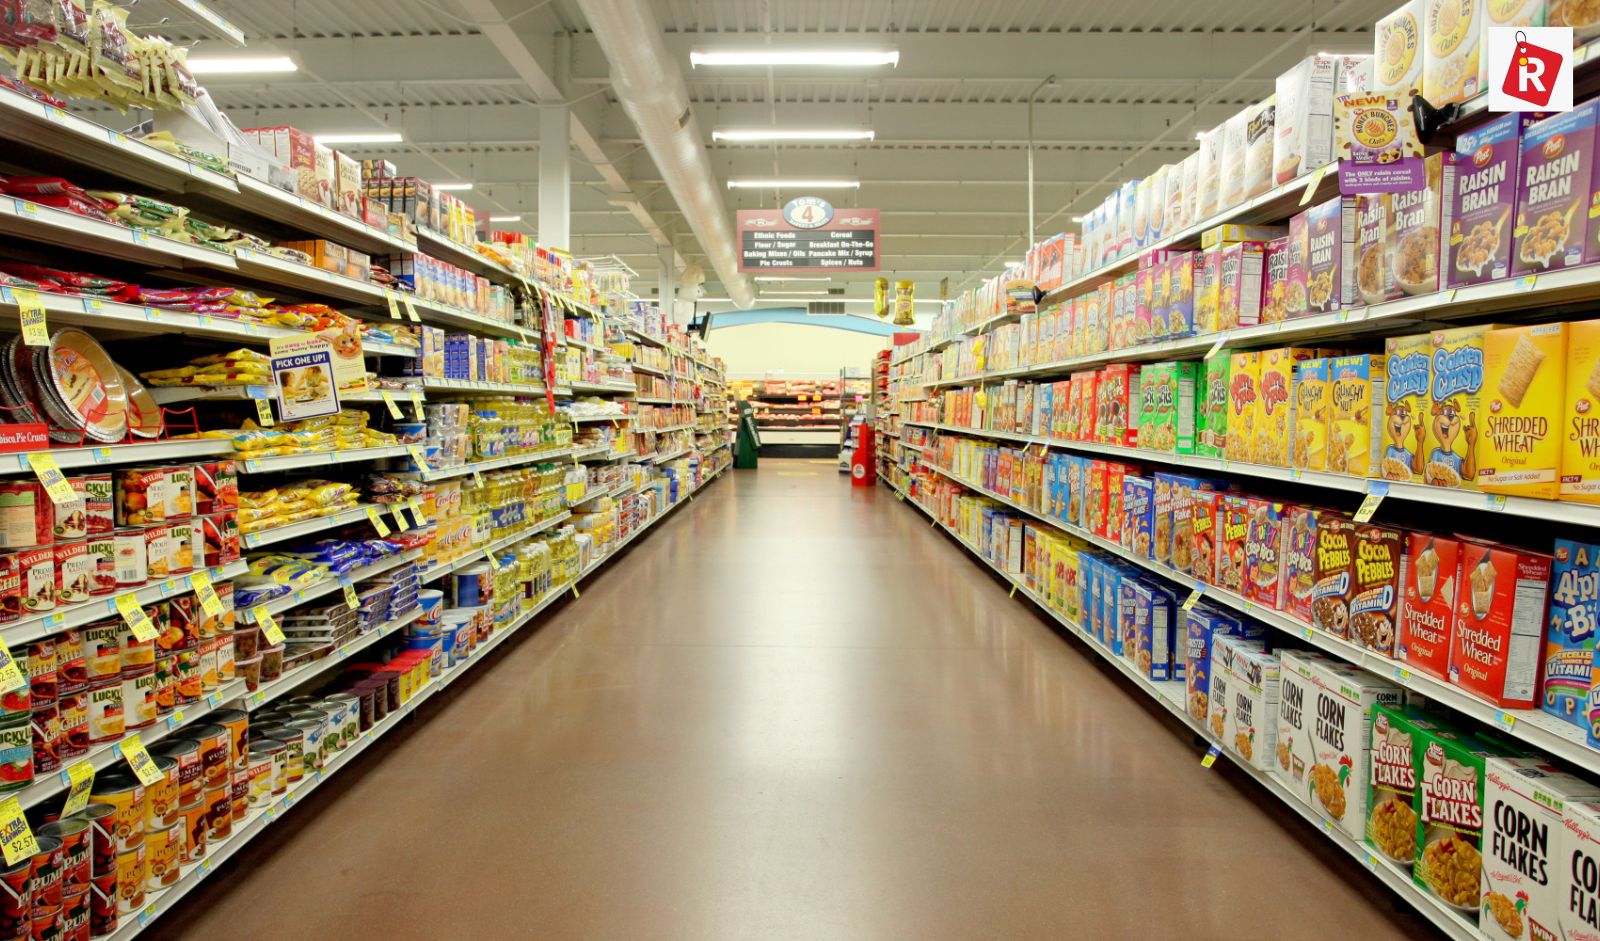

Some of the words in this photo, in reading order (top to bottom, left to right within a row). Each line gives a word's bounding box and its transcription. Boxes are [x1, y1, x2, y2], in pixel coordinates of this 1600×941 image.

[1344, 96, 1385, 107] NEW!
[1356, 113, 1369, 133] HONEY
[1370, 111, 1395, 132] BUNCHES
[1475, 149, 1489, 164] Post
[1544, 138, 1562, 154] Post
[1459, 160, 1506, 195] RAISIN
[1526, 150, 1580, 187] RAISIN
[1391, 192, 1431, 210] Raisin
[1462, 185, 1499, 214] BRAN
[1528, 175, 1572, 206] BRAN
[802, 206, 814, 222] 4
[1357, 205, 1385, 227] Raisin
[1395, 208, 1425, 231] Bran
[1310, 230, 1335, 252] RAISIN
[1360, 223, 1381, 245] Bran
[1311, 249, 1332, 266] BRAN
[21, 308, 42, 319] EXTRA
[276, 359, 293, 368] PICK
[295, 356, 311, 364] ONE
[1301, 360, 1322, 369] NEW!
[1336, 357, 1364, 367] NEW!
[1389, 352, 1429, 376] Golden
[1434, 346, 1483, 373] Golden
[1298, 382, 1323, 406] CRUNCHY
[1332, 382, 1365, 407] CRUNCHY
[1303, 399, 1314, 413] NUT
[1340, 398, 1353, 413] NUT
[16, 432, 26, 442] Pie
[27, 432, 46, 441] Crusts
[1485, 416, 1548, 438] SHREDDED
[1493, 435, 1543, 453] WHEAT
[1501, 456, 1526, 467] Original
[1494, 475, 1508, 483] Sugar
[1193, 516, 1212, 534] PEBBLES
[1320, 530, 1348, 550] COCOA
[1358, 540, 1390, 560] COCOA
[1318, 547, 1350, 572] PEBBLES
[1518, 562, 1547, 572] Shredded
[1356, 559, 1394, 585] PEBBLES
[1404, 603, 1445, 631] Shredded
[86, 628, 115, 642] LUCKY
[1408, 621, 1438, 644] Wheat
[1457, 619, 1501, 651] Shredded
[1411, 642, 1434, 658] Original
[1461, 640, 1493, 666] Wheat
[1463, 663, 1488, 681] Original
[93, 689, 121, 703] LUCKY
[1214, 676, 1226, 694] CORN
[1282, 678, 1304, 711] CORN
[1213, 689, 1225, 708] FLAKES
[1237, 692, 1252, 714] CORN
[1376, 692, 1397, 703] CORN
[1236, 707, 1252, 726] FLAKES
[1281, 700, 1302, 730] FLAKES
[1317, 693, 1345, 730] CORN
[1316, 717, 1344, 752] FLAKES
[1380, 741, 1410, 767] CORN
[1370, 749, 1416, 789] FLAKES
[1433, 774, 1474, 803] CORN
[1420, 782, 1482, 828] FLAKES
[1494, 799, 1548, 858] CORN
[12, 836, 34, 852] $2.57
[1492, 830, 1548, 886] FLAKES
